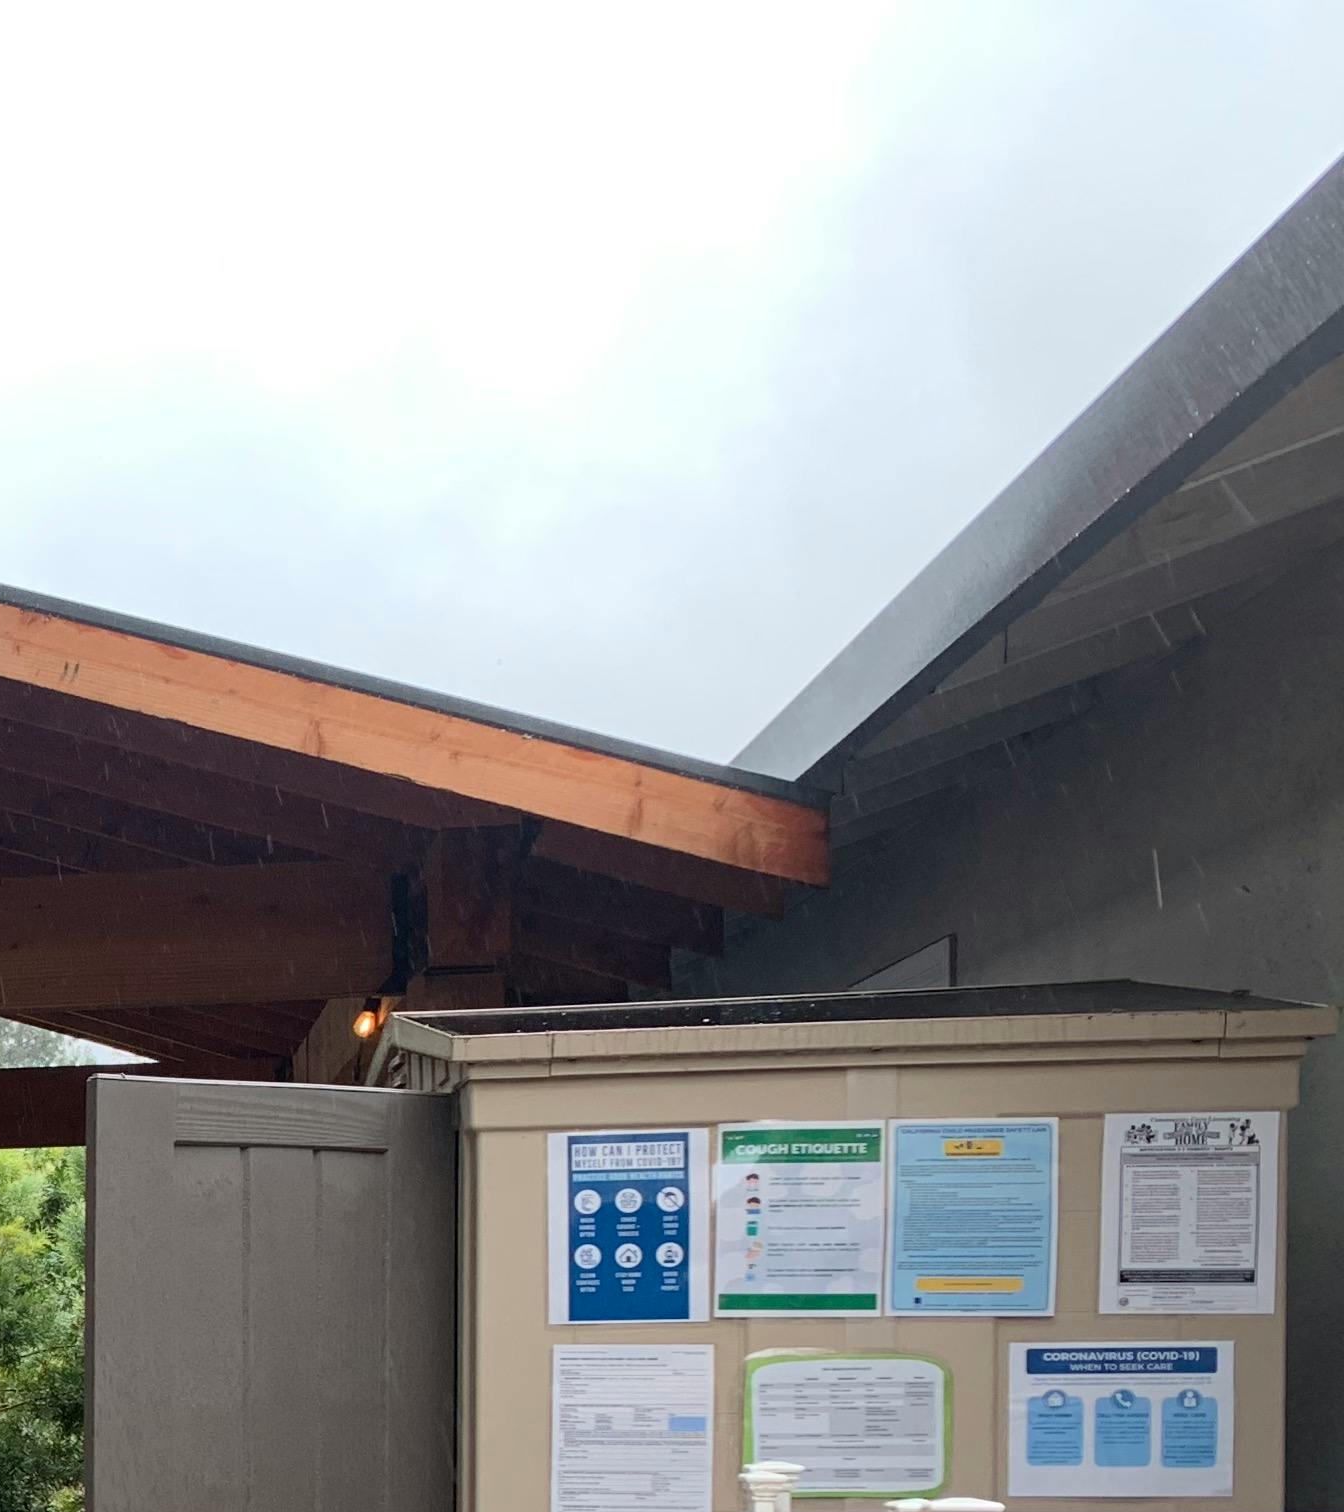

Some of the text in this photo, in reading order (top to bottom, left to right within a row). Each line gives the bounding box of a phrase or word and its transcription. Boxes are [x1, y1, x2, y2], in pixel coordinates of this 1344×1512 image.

[1174, 1121, 1210, 1132] FAMILY
[1174, 1134, 1208, 1146] HOME
[574, 1146, 597, 1157] HOW
[601, 1145, 623, 1156] CAN
[635, 1143, 681, 1156] PROTECT
[735, 1142, 868, 1156] COUGH ETIQUETTE
[574, 1158, 606, 1169] MYSELF
[610, 1157, 634, 1168] FROM
[1043, 1350, 1201, 1362] CORONAVIRUS (COVID-19)
[1070, 1362, 1173, 1371] WHEN TO SEEK CARE
